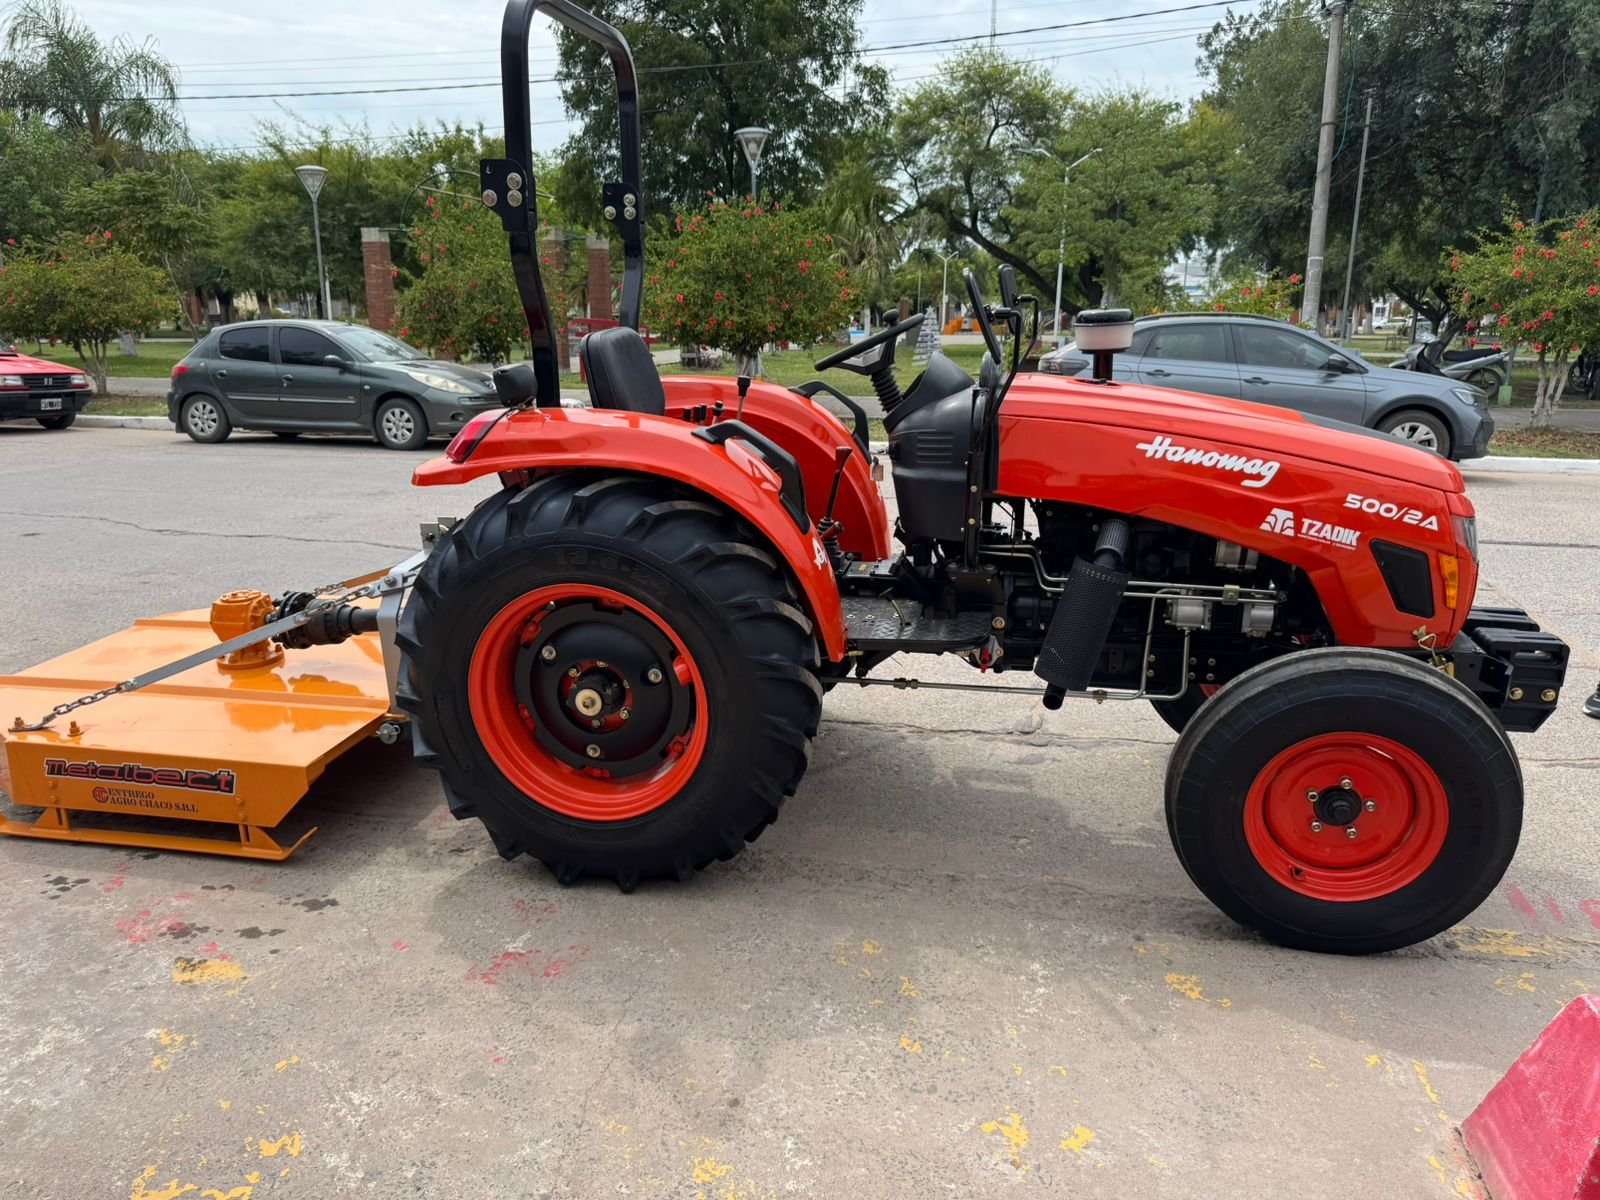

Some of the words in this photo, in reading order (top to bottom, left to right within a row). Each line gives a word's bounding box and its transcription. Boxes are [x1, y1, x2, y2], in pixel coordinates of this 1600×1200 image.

[1136, 435, 1281, 487] Hanomag
[1343, 493, 1439, 531] 500/2A
[1301, 517, 1361, 546] TZADIK
[108, 787, 155, 800] ENTREGO
[110, 796, 137, 807] AGRO
[139, 799, 173, 810] CHACO
